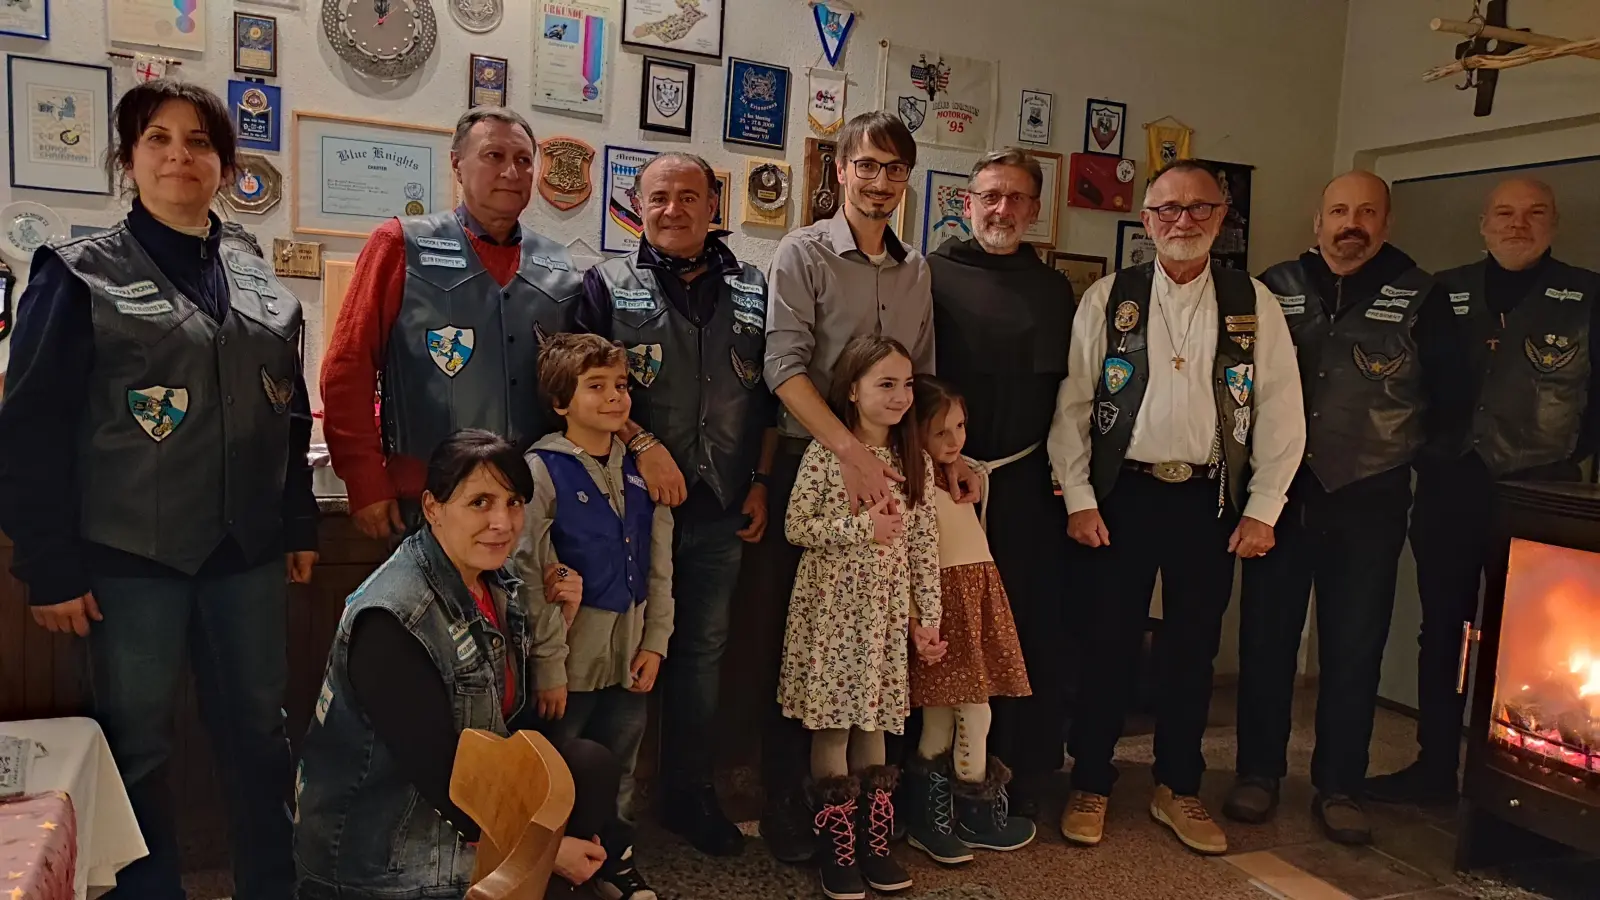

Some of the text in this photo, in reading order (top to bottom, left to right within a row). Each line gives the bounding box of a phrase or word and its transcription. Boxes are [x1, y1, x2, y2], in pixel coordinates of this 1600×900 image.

[544, 3, 584, 19] URKUNDE
[336, 147, 419, 171] Blue Knights
